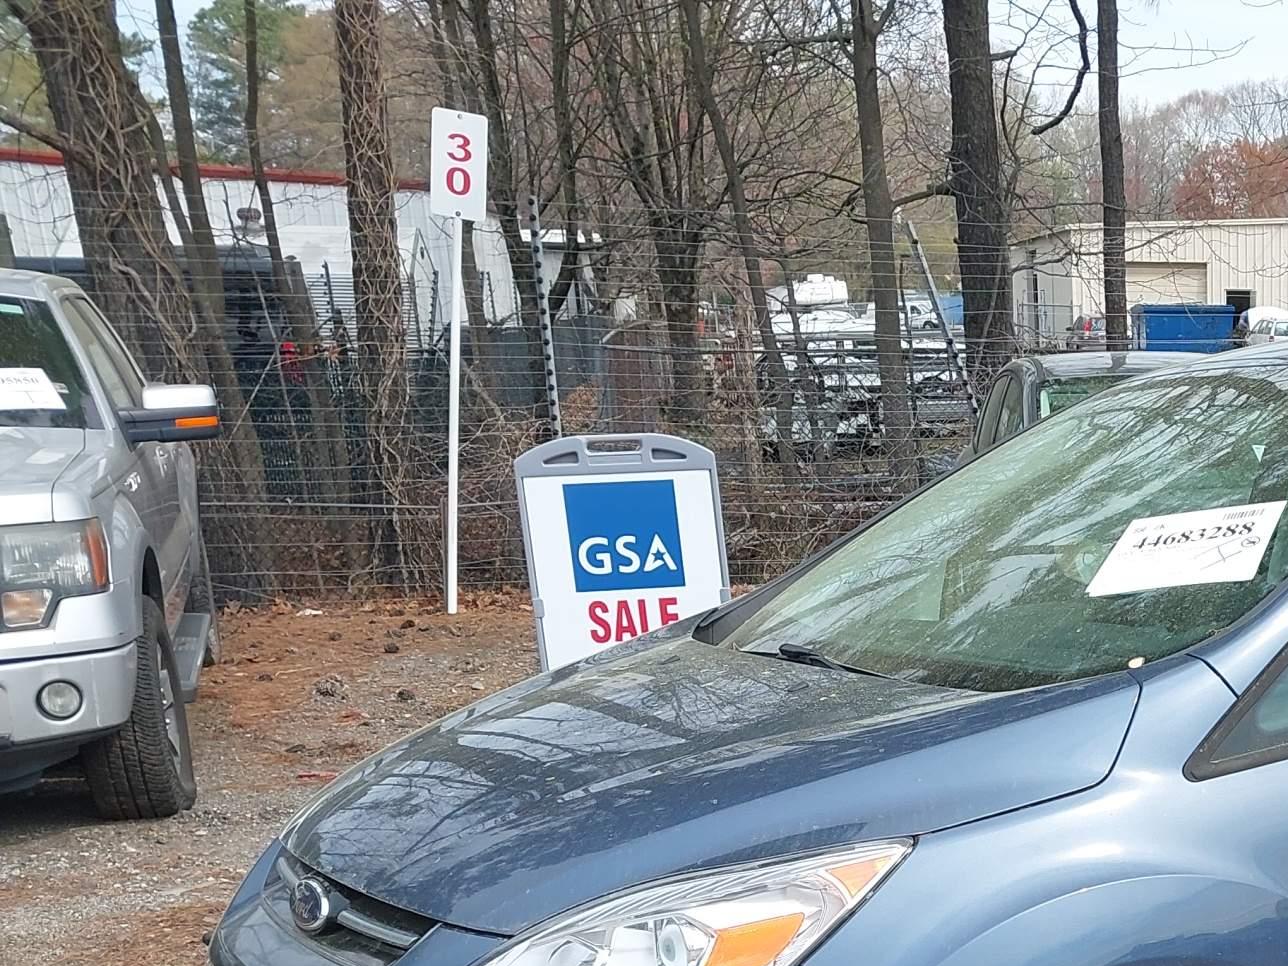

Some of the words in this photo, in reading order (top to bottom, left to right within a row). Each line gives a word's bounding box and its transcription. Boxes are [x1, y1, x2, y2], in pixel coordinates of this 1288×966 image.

[446, 133, 472, 196] 30
[578, 533, 678, 575] GSA
[1132, 521, 1256, 550] 44683288
